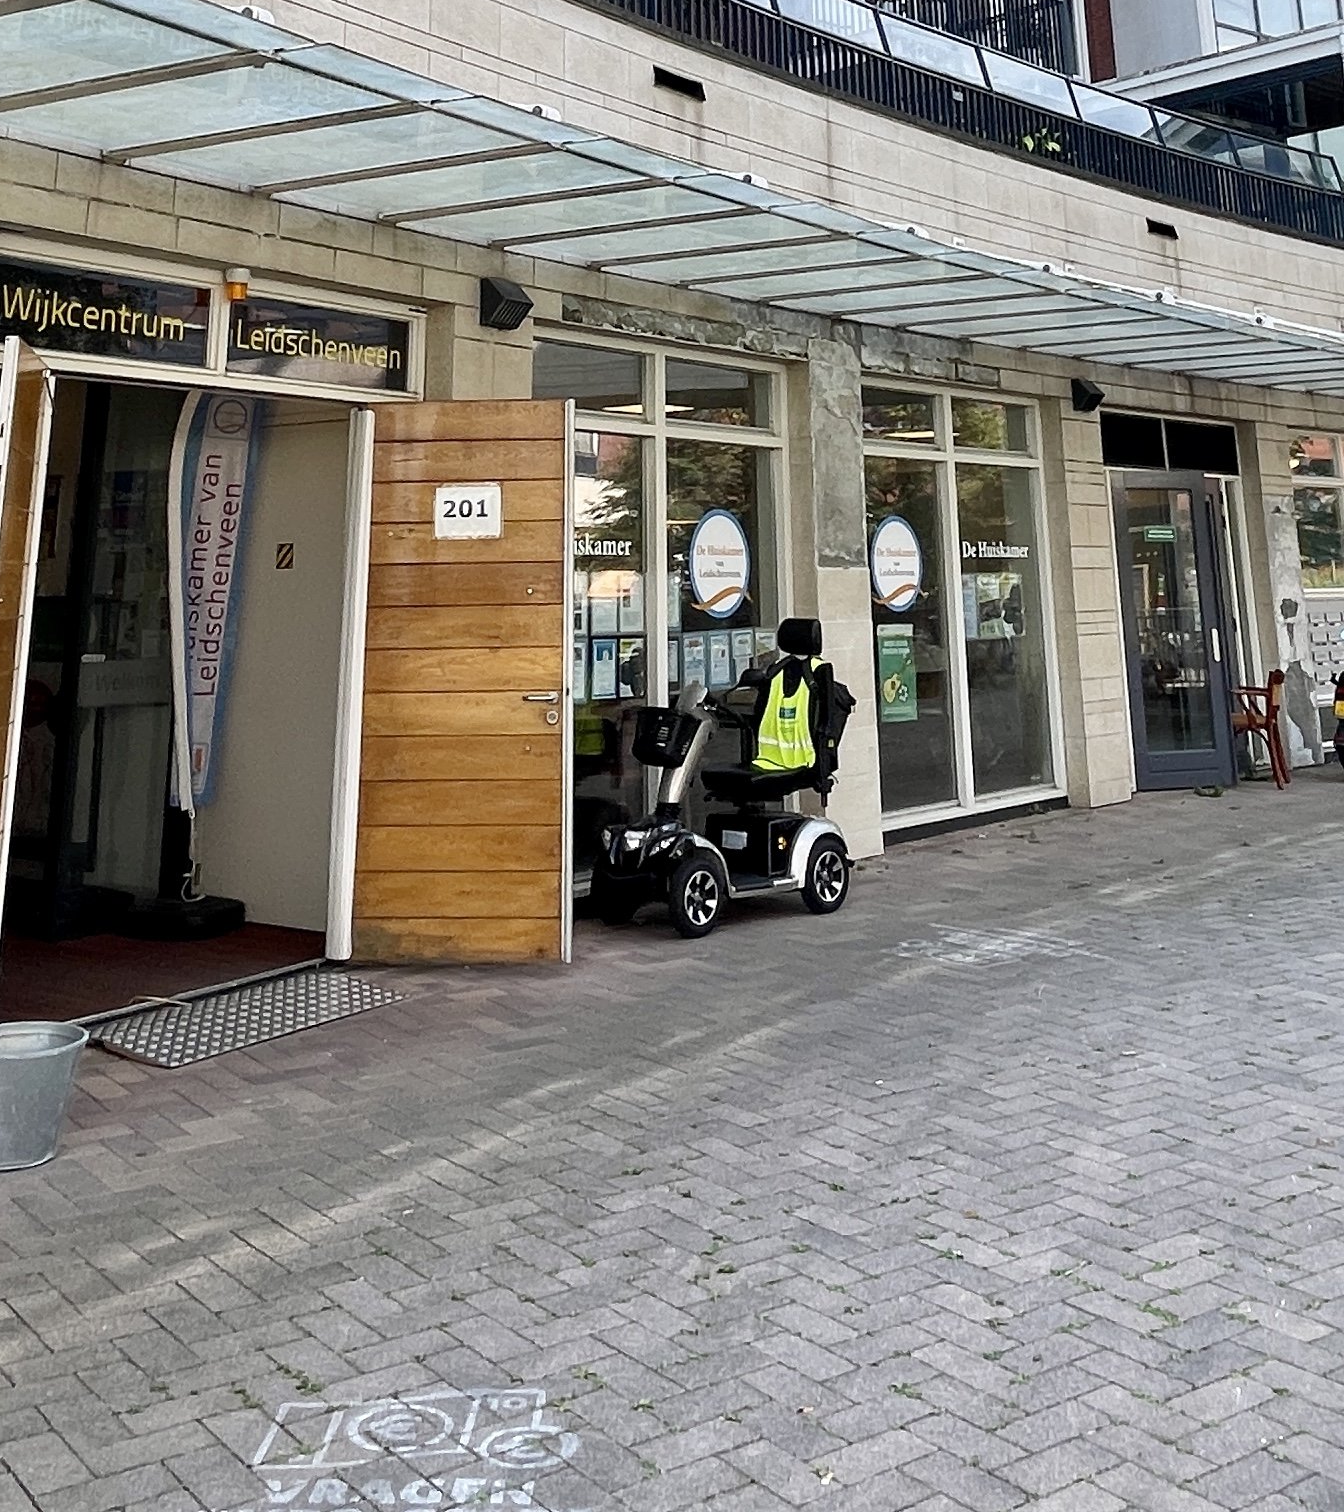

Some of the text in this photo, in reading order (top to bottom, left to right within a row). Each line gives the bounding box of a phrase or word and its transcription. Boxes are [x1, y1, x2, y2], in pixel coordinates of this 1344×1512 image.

[3, 284, 401, 370] Wijkcentrum Leidschenveen
[199, 453, 223, 504] van
[443, 499, 488, 518] 201
[962, 541, 1029, 558] De Huiskamer
[192, 482, 243, 698] Leidschenveen
